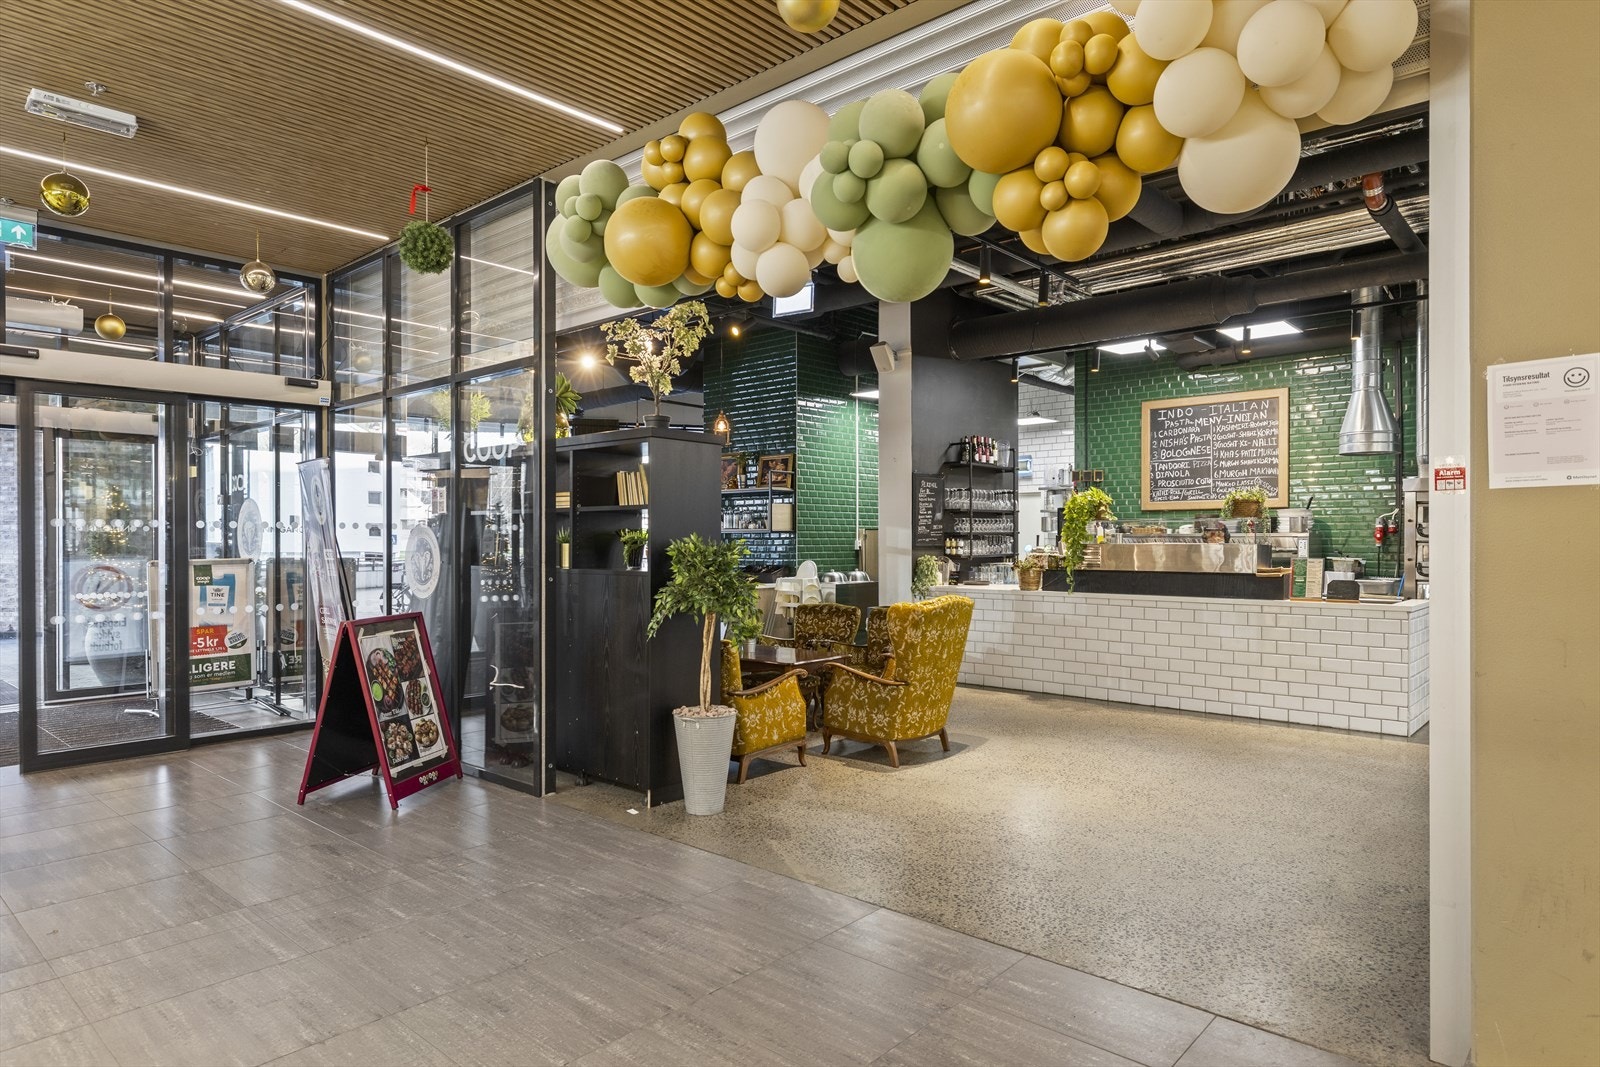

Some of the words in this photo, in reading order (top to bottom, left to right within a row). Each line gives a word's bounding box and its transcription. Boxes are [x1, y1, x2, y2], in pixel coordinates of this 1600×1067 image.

[1502, 372, 1550, 383] Tilsynsresultat
[1157, 407, 1194, 420] INDO
[1189, 433, 1212, 444] PASTA
[1160, 446, 1212, 460] BOLOGNESE
[1153, 461, 1191, 471] TANDOORI
[1155, 469, 1190, 479] DIAVOLA
[1439, 469, 1461, 477] Alarm
[206, 635, 219, 648] kr
[189, 660, 236, 674] LIGERE
